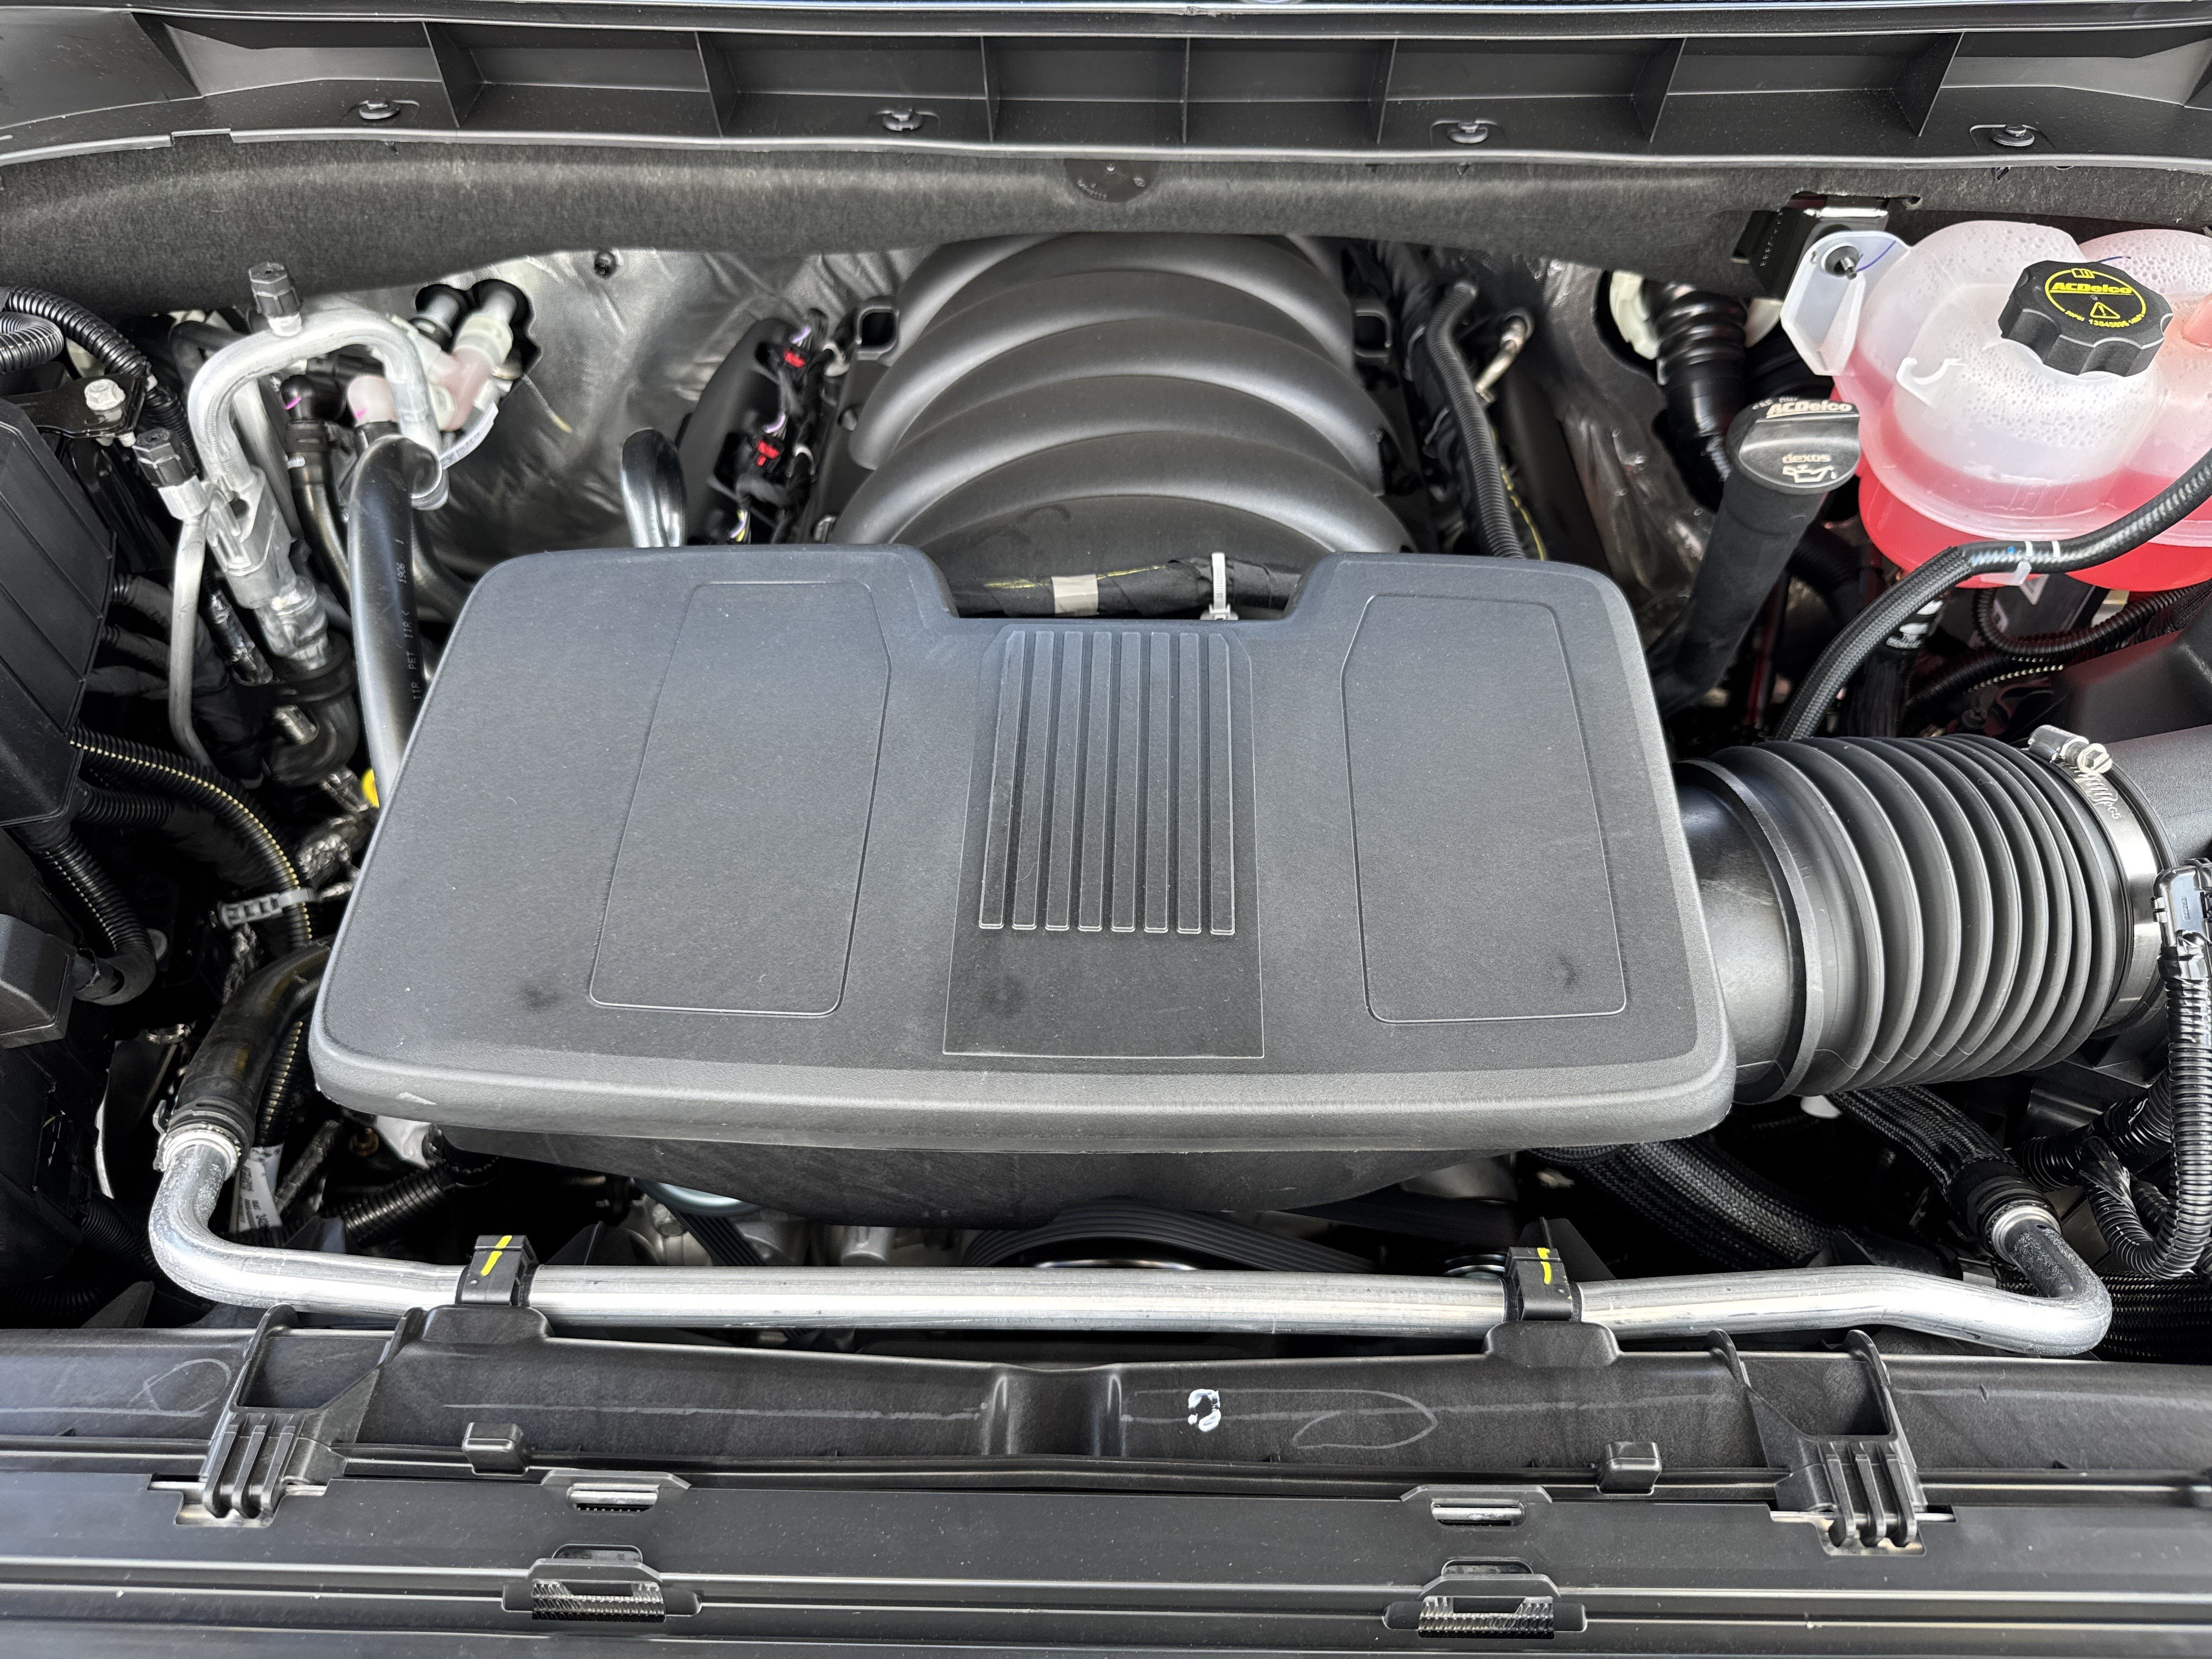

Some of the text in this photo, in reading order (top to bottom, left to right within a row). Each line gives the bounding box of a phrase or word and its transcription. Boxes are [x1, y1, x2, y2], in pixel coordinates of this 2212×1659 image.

[2051, 282, 2132, 294] ACDelco
[1766, 399, 1853, 415] ACDelco
[1781, 453, 1832, 464] dexos
